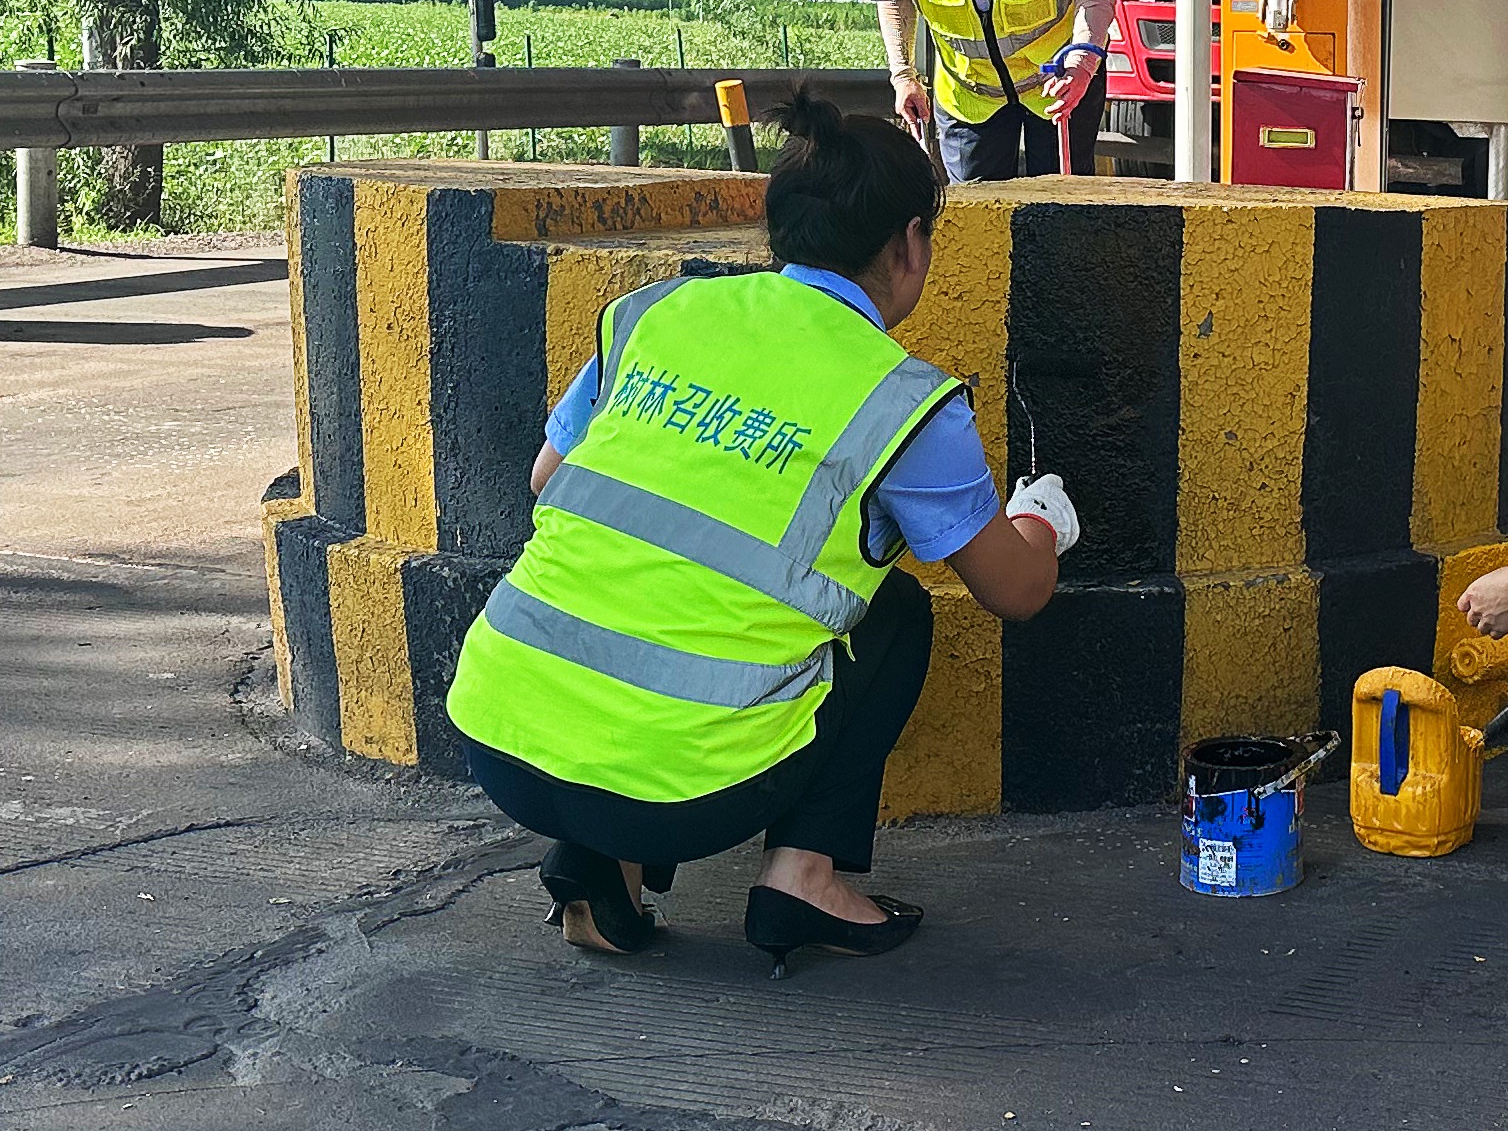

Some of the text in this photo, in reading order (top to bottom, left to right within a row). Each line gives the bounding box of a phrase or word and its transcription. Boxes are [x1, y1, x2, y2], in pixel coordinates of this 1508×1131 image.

[608, 361, 812, 475] 树林召收费所
